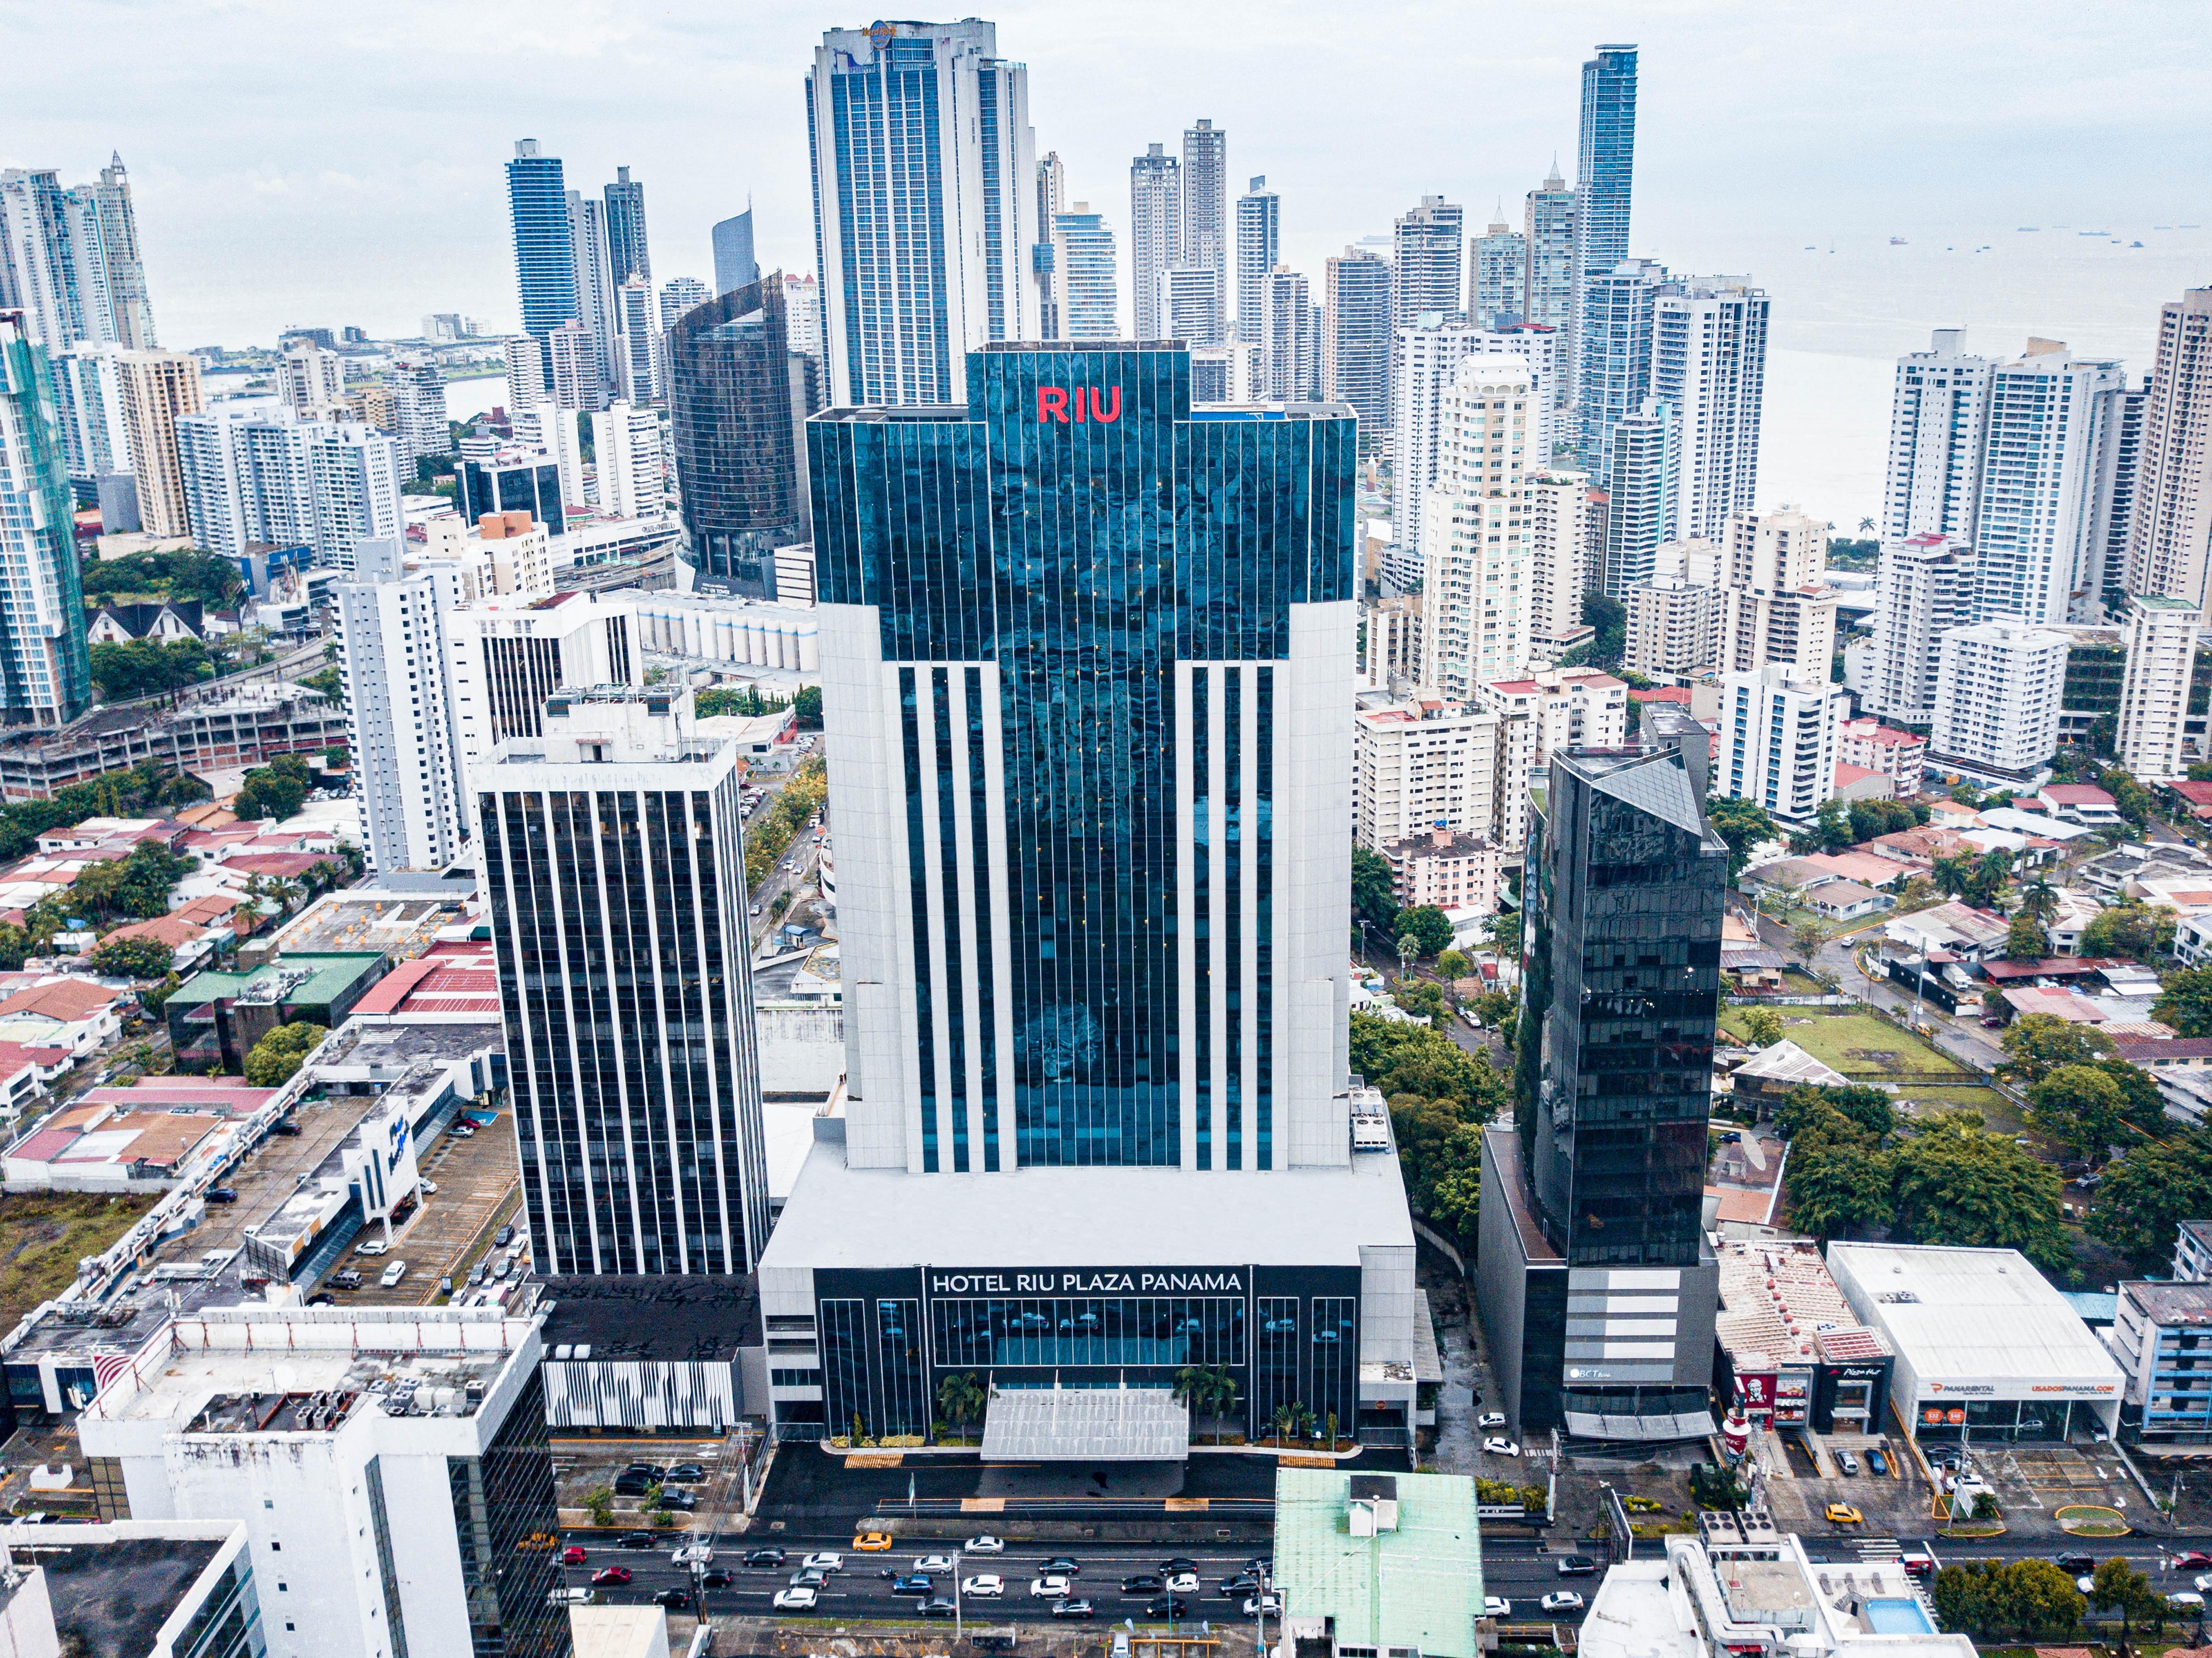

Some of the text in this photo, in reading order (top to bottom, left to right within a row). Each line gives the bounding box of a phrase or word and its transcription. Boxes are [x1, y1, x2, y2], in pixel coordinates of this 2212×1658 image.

[1038, 386, 1120, 424] RIU
[933, 1273, 1241, 1291] HOTEL RIU PLAZA PANAMA
[1780, 1398, 1806, 1406] KFC
[1726, 1437, 1741, 1445] KFC
